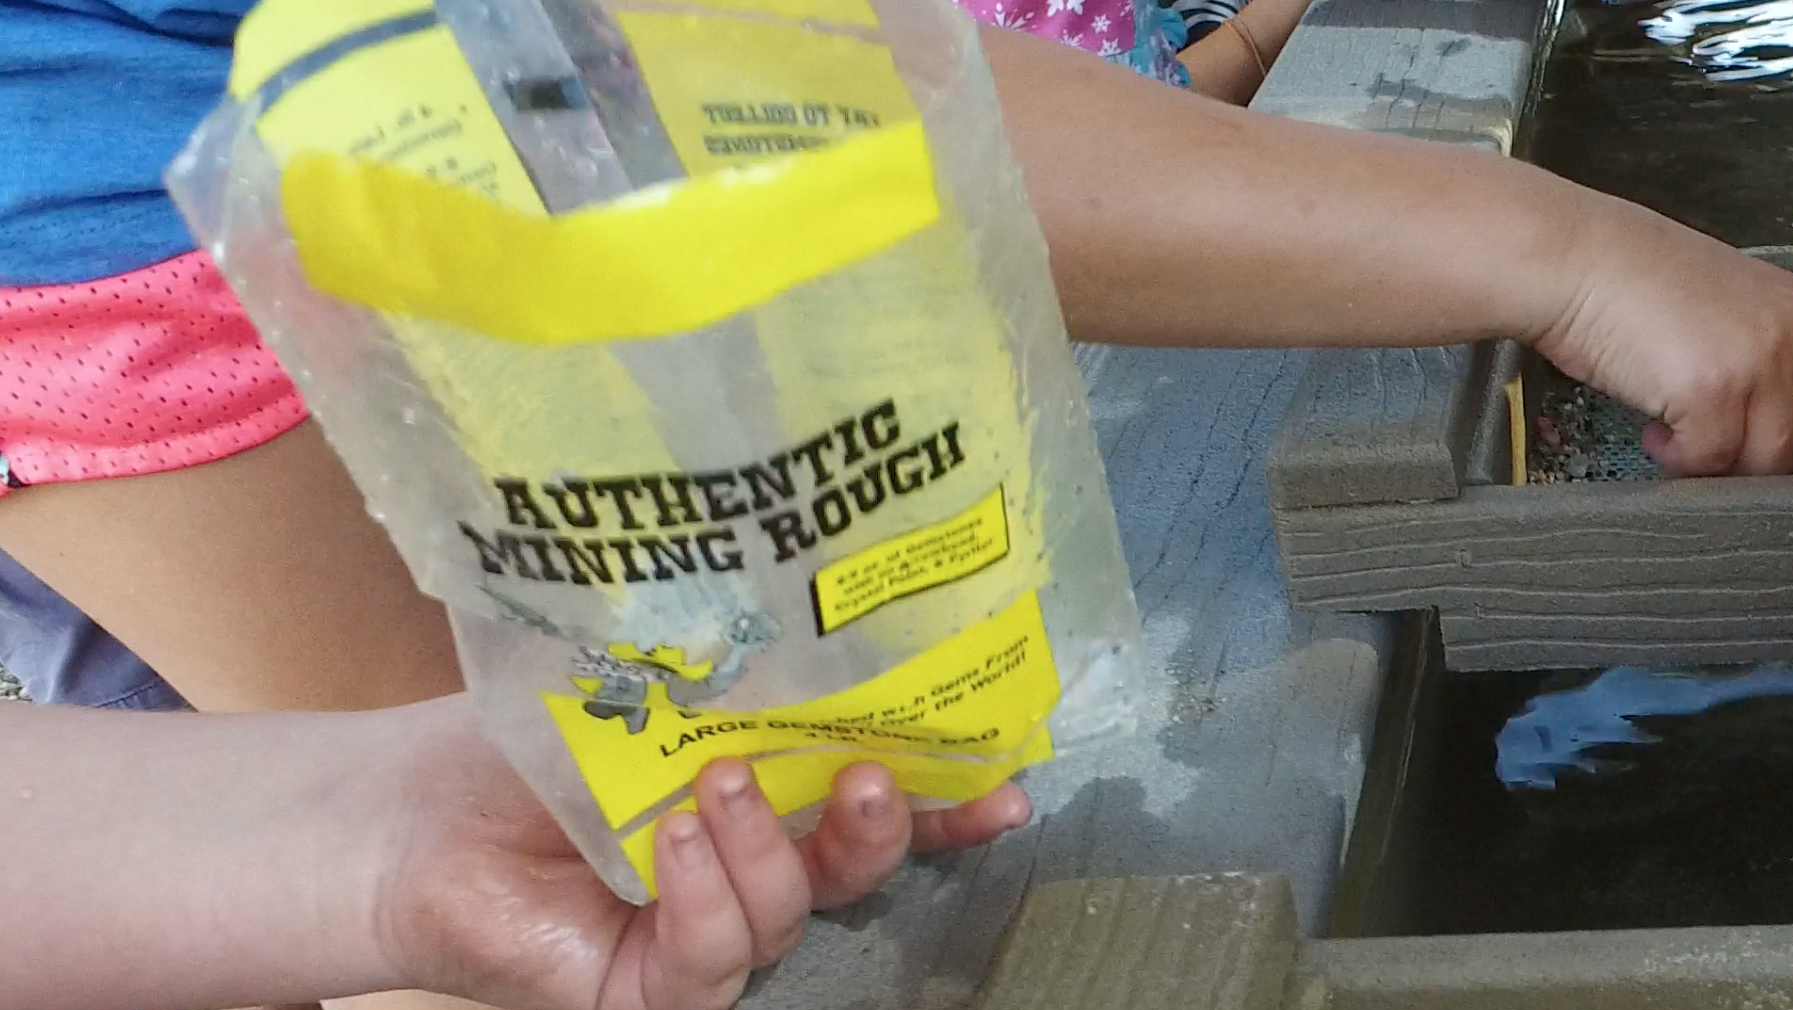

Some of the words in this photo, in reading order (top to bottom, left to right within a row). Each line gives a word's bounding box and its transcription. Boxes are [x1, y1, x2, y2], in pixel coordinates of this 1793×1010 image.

[456, 520, 744, 586] MINING
[759, 421, 965, 563] ROUGH
[494, 399, 900, 530] AUTHENTIC
[660, 720, 759, 757] LARGE
